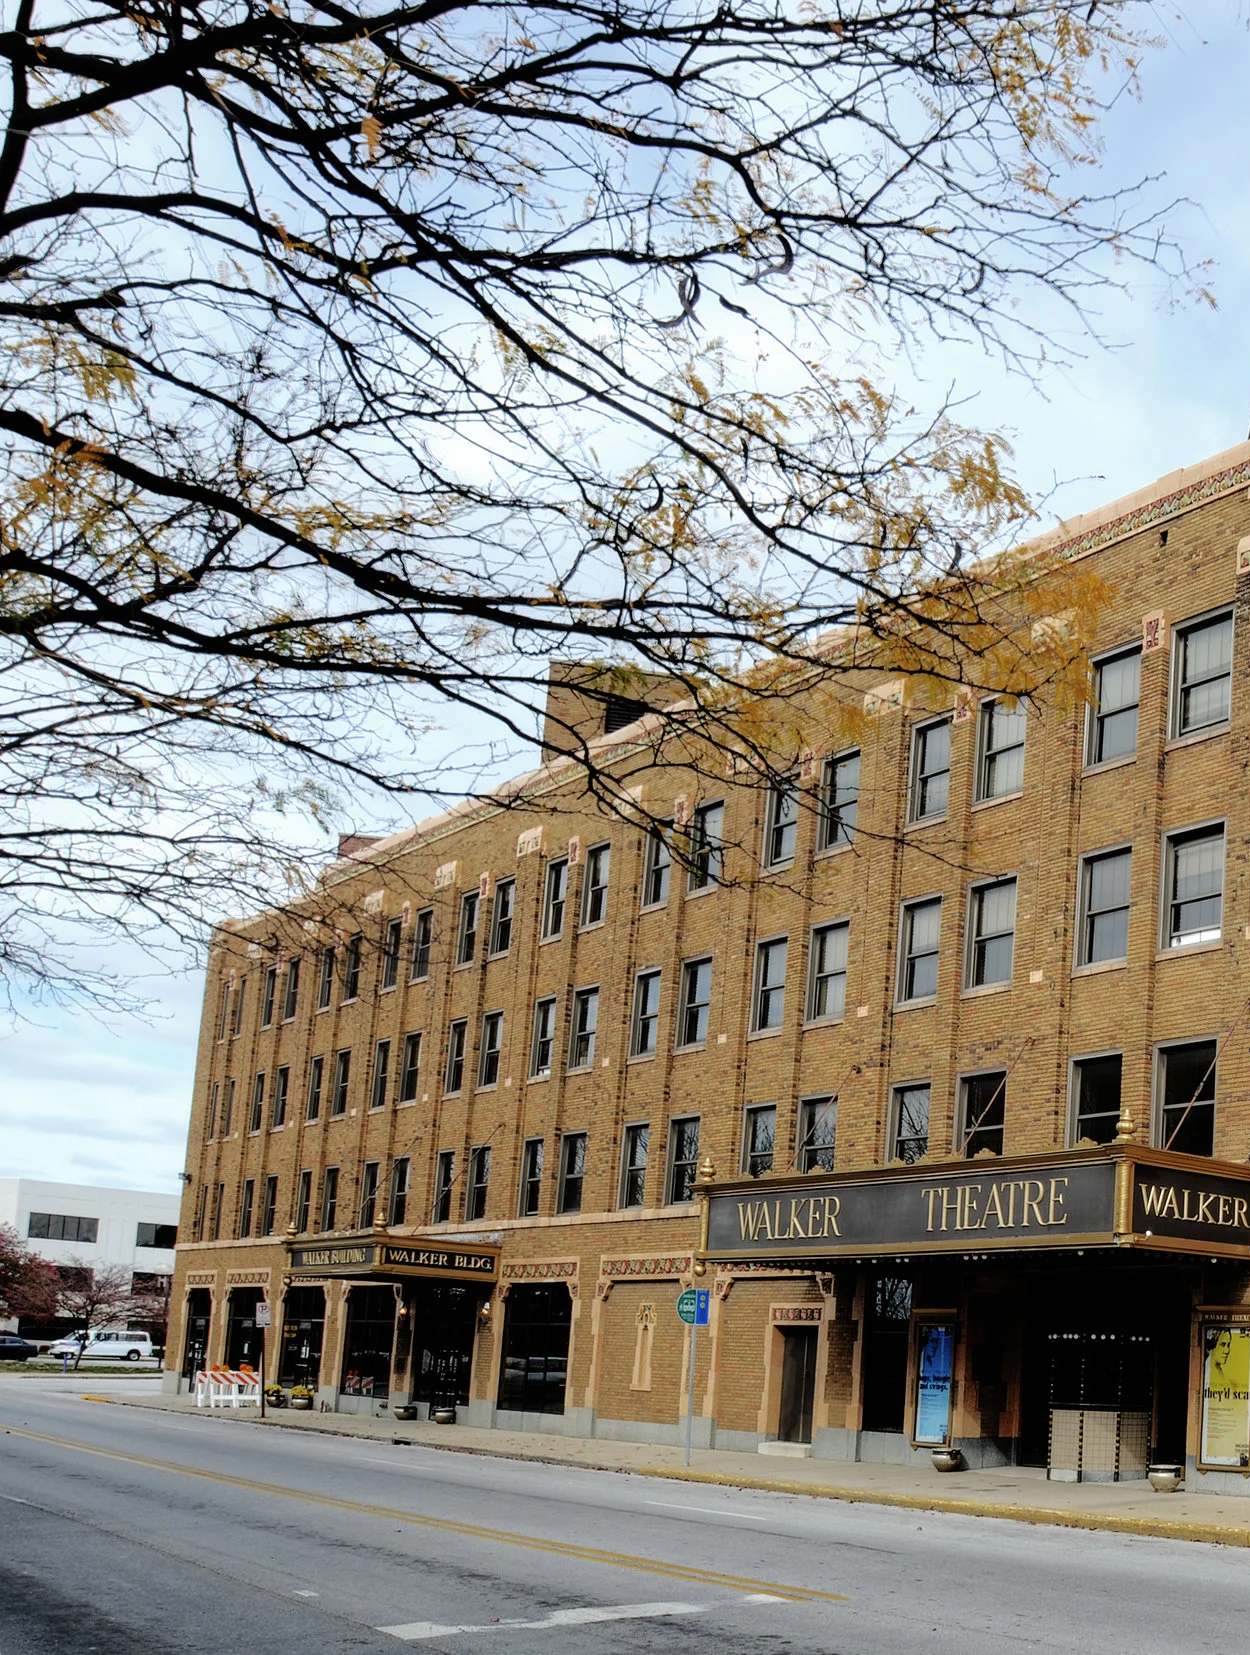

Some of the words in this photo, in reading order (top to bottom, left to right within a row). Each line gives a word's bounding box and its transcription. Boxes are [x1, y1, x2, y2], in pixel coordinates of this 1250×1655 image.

[737, 1196, 842, 1241] WALKER
[921, 1177, 1069, 1232] THEATRE
[1139, 1183, 1250, 1229] WALKER
[302, 1251, 329, 1265] WALKER
[331, 1248, 366, 1263] BUILDING
[389, 1250, 448, 1266] WALKER
[454, 1255, 492, 1270] BLDG.
